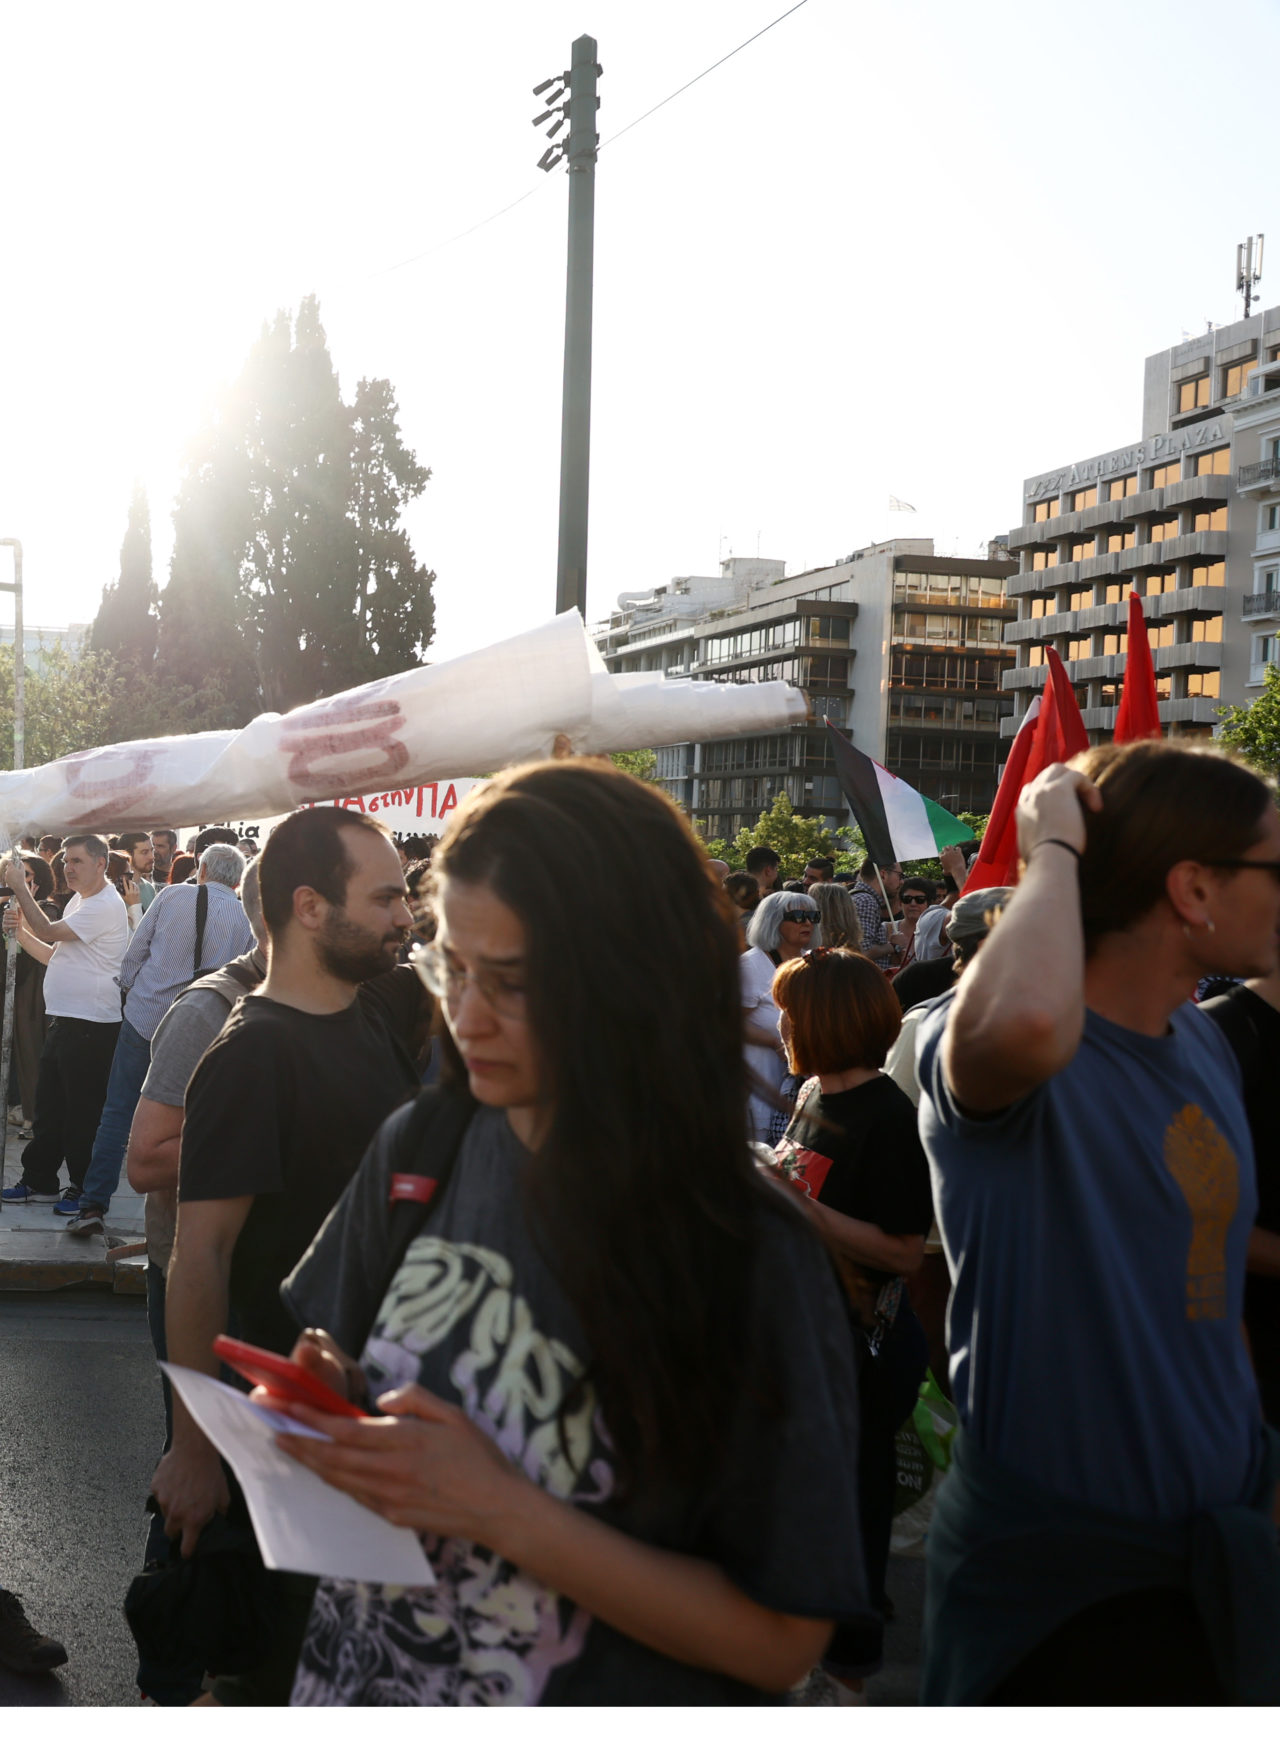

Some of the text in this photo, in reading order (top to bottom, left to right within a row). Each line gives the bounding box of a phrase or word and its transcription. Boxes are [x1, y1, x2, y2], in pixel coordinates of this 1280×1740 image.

[1068, 446, 1146, 487] ATHENS
[1150, 423, 1225, 461] PLAZA
[416, 782, 460, 820] ΠΑ
